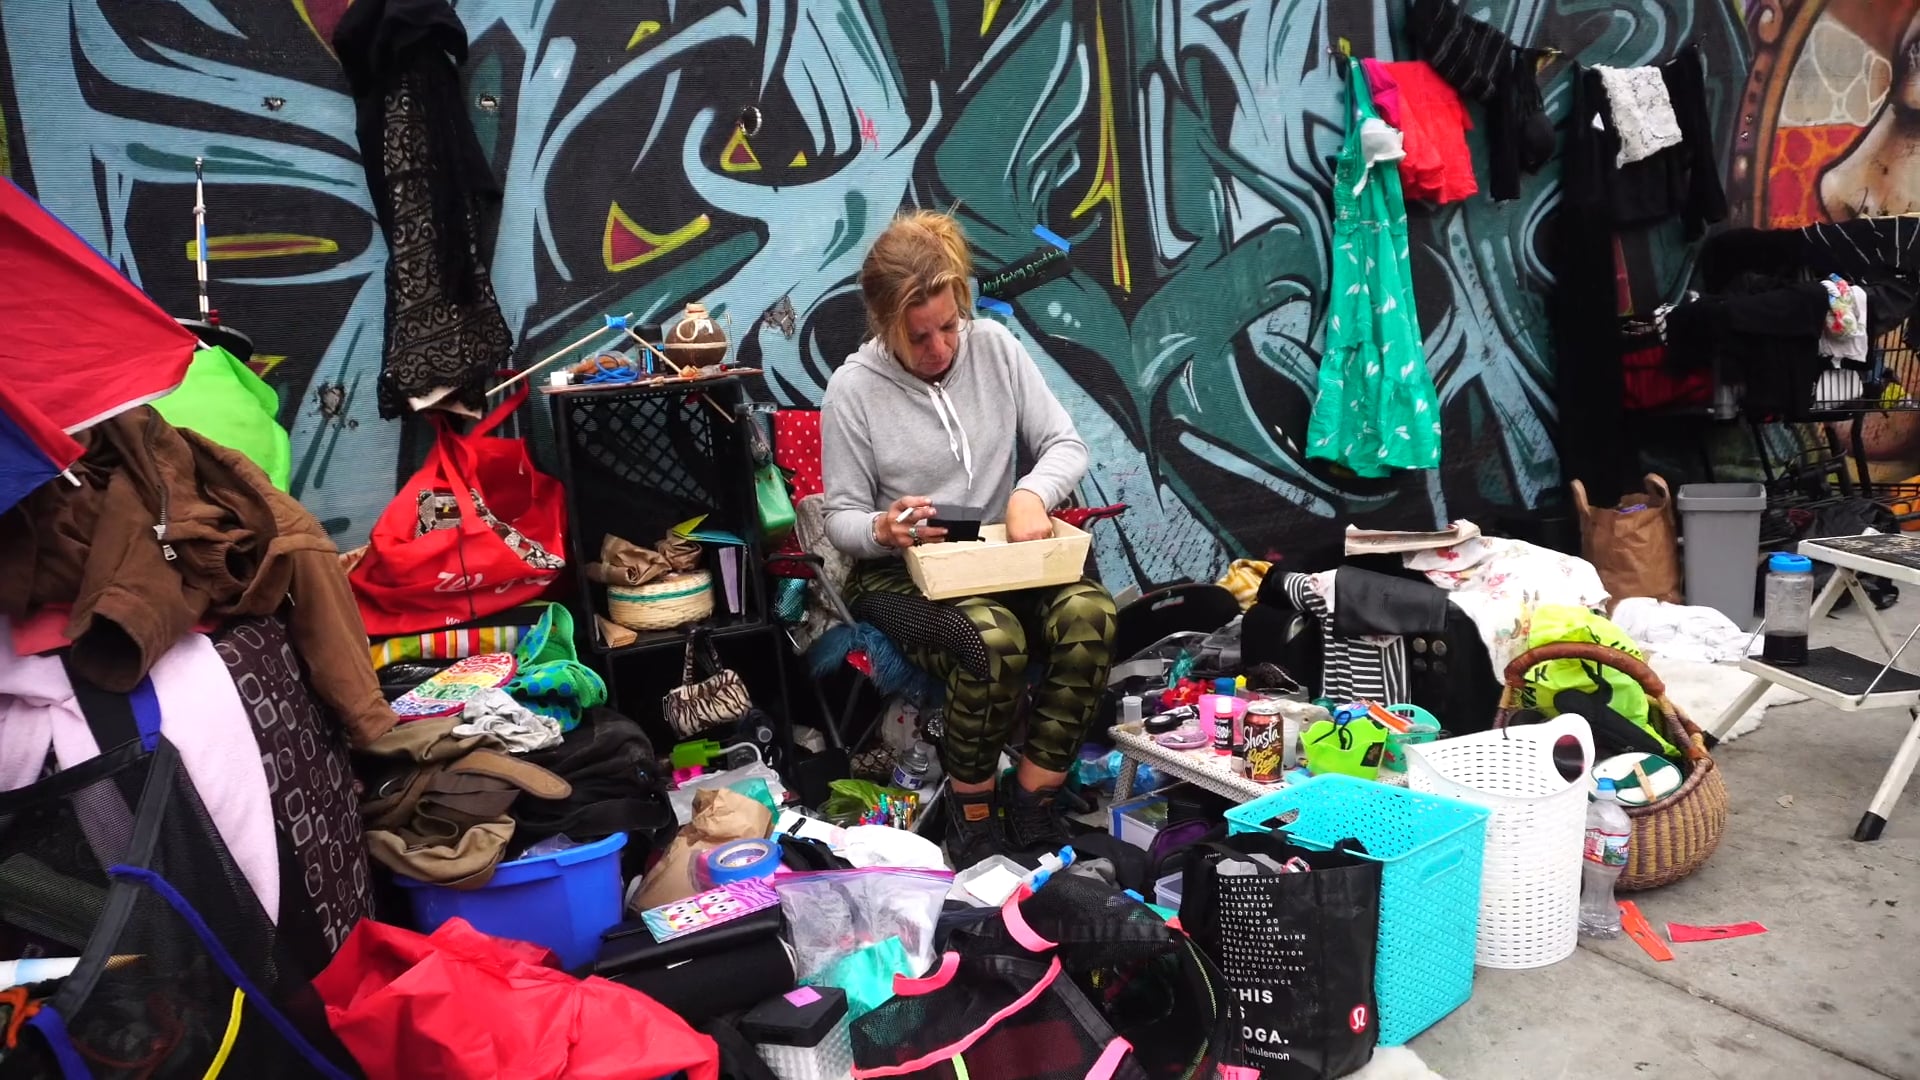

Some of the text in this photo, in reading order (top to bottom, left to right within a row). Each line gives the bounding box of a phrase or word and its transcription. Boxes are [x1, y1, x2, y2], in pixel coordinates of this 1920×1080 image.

[1243, 721, 1280, 752] Shasta
[1248, 745, 1273, 762] Root
[1254, 754, 1280, 775] Beer
[1219, 893, 1271, 901] STILLNESS
[1220, 916, 1261, 925] LETTING
[1221, 923, 1280, 933] MEDITATION
[1221, 930, 1306, 941] SELF-DISCIPLINE
[1222, 937, 1274, 949] INTENTION
[1222, 944, 1304, 957] CONCENTRATION
[1222, 952, 1283, 963] GENEROSITY
[1223, 960, 1306, 972] SELF-DISCOVERY
[1223, 967, 1258, 976] PURITY
[1224, 975, 1292, 986] NONVIOLENCE
[1242, 1025, 1290, 1044] OGA.
[1244, 1043, 1290, 1061] lululemon
